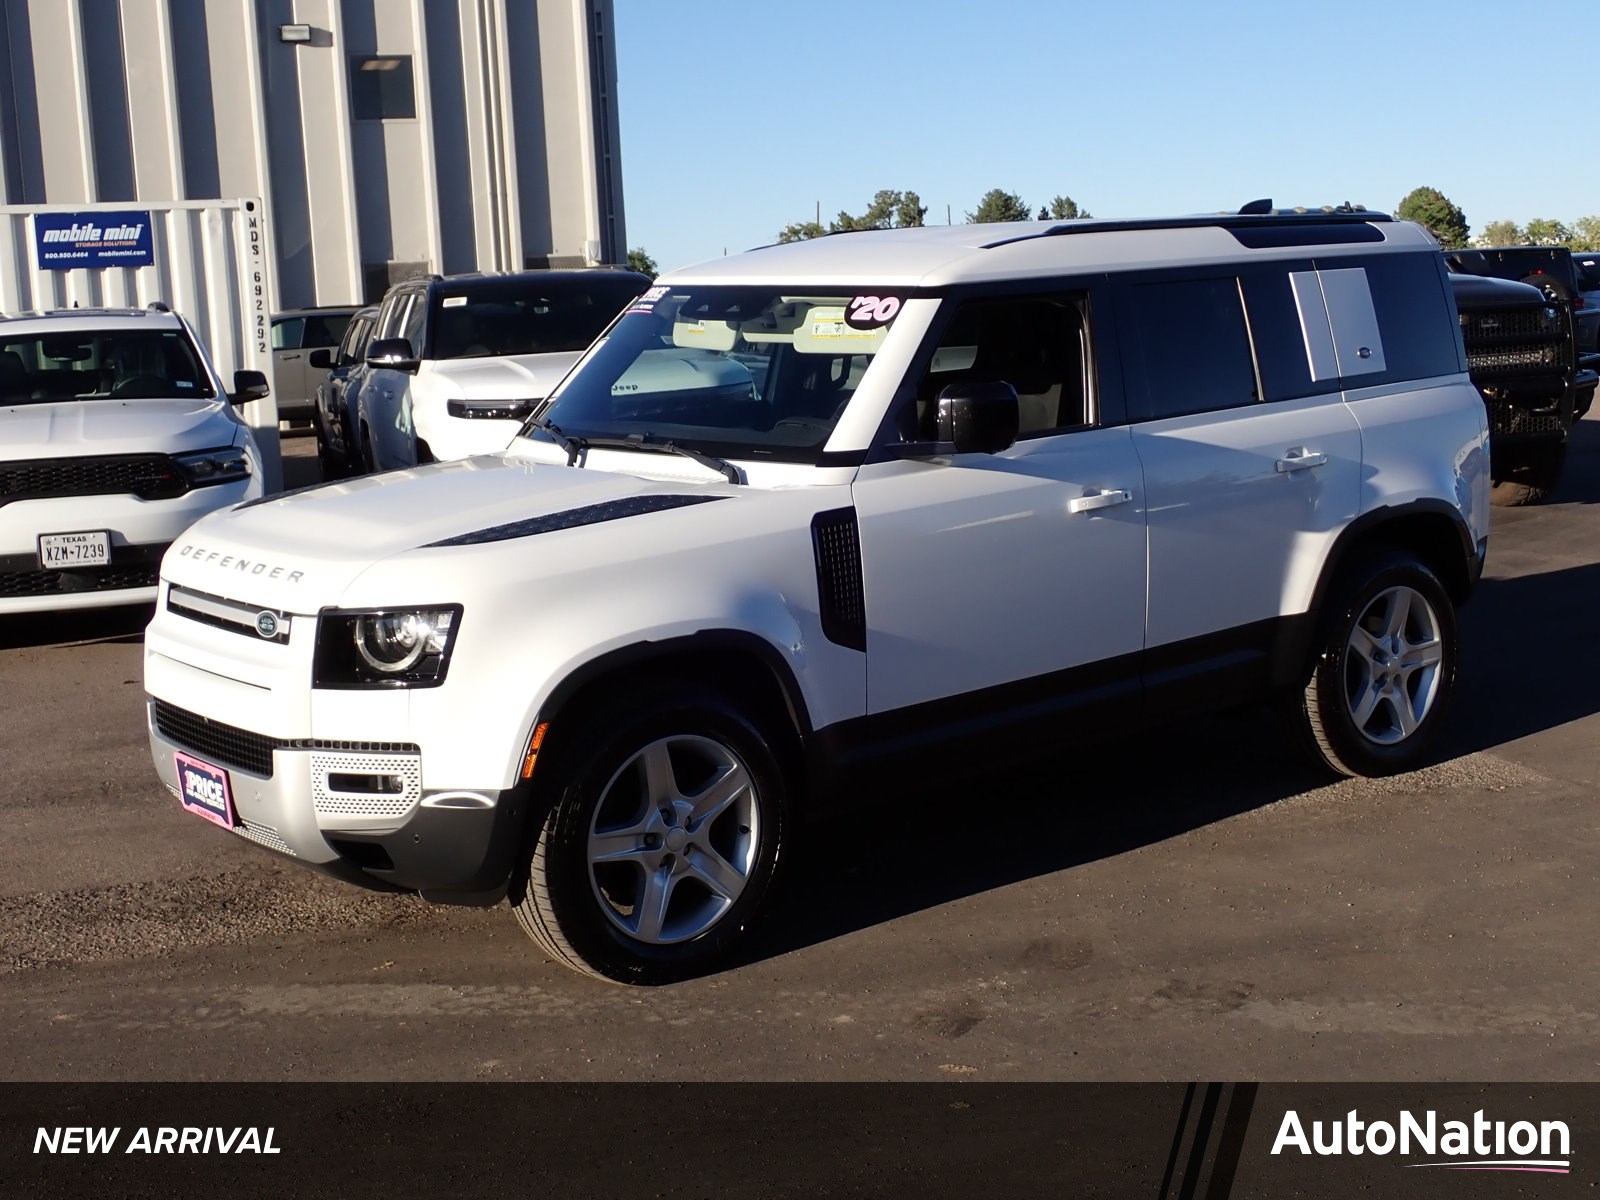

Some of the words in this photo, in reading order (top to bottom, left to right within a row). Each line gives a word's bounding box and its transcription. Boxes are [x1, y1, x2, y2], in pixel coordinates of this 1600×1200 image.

[43, 223, 101, 242] mobile
[103, 224, 142, 240] mini
[46, 543, 104, 561] XZM-7239
[180, 545, 304, 583] DEFENDER
